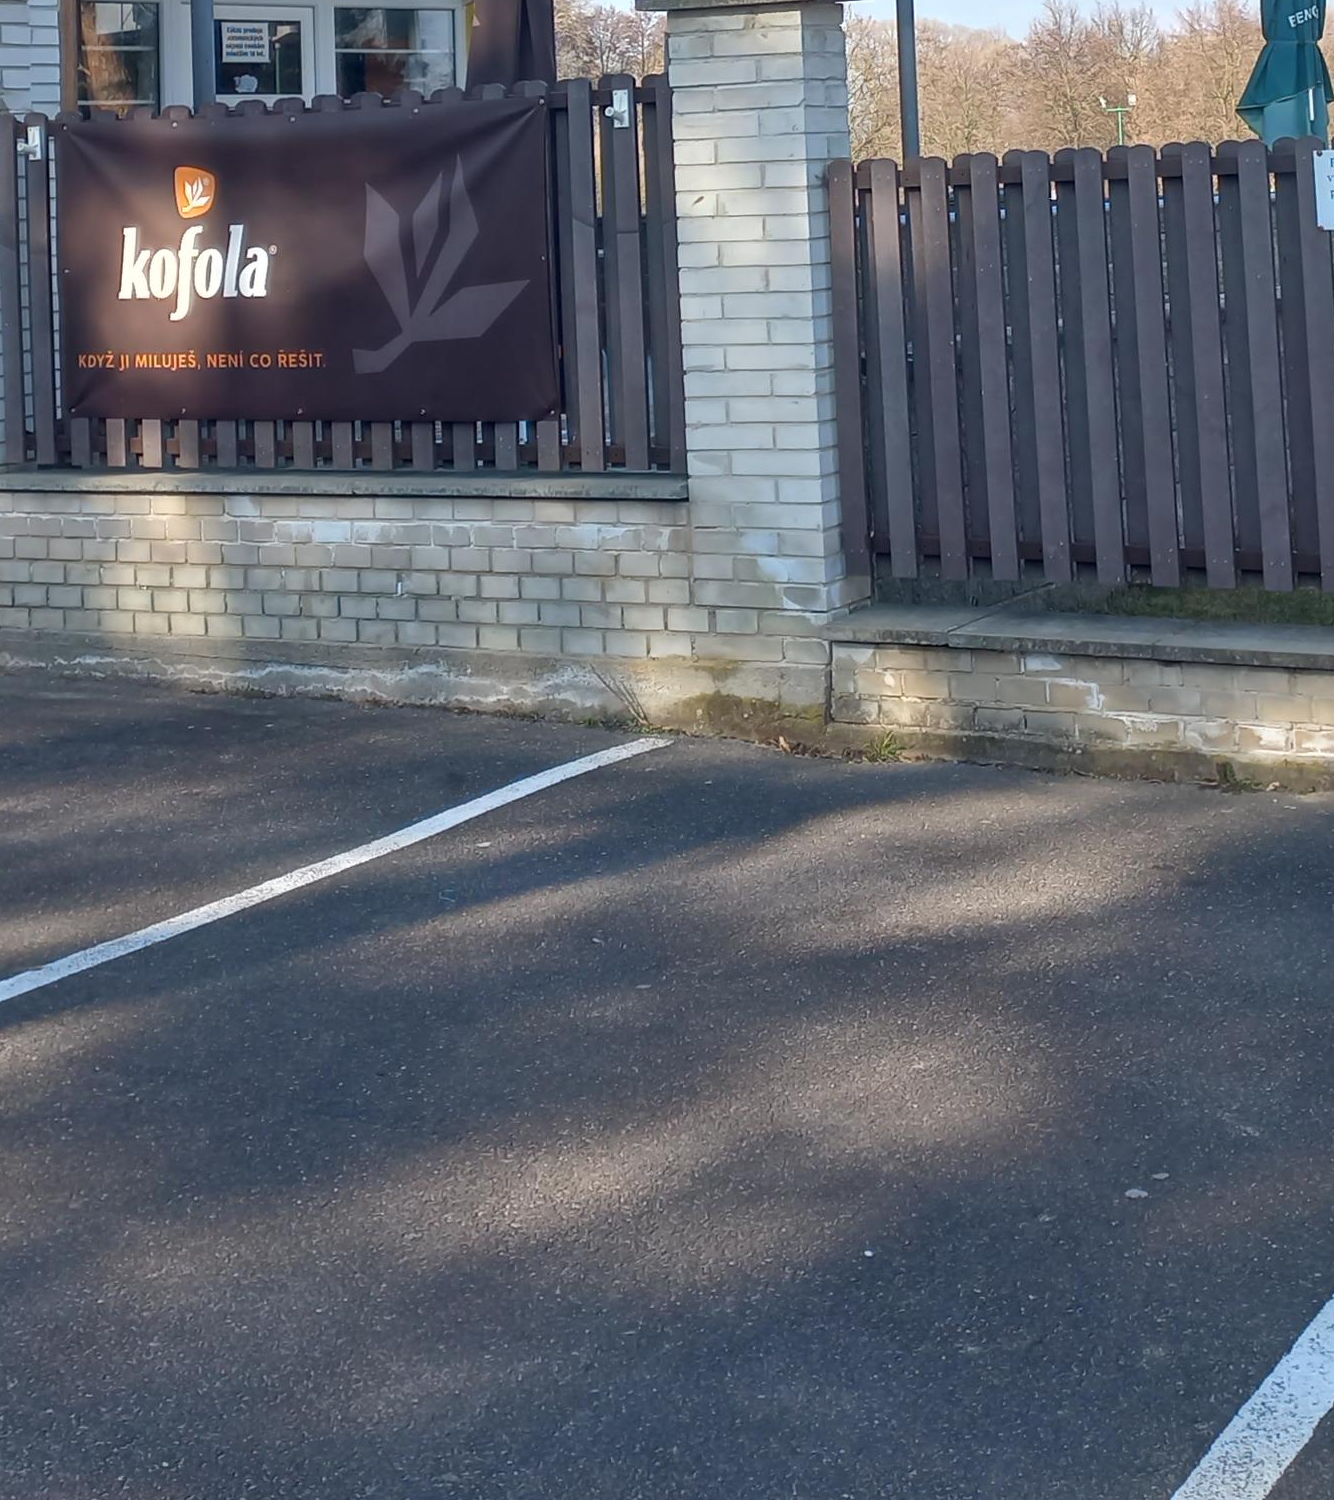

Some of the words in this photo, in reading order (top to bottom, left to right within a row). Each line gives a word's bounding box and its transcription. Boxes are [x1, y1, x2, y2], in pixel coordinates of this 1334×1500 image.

[118, 224, 269, 322] kofola
[78, 350, 115, 368] KDYŽ
[119, 353, 130, 371] JI
[135, 349, 201, 371] MILUJEŠ,
[207, 350, 244, 368] NENÍ
[249, 353, 272, 368] CO
